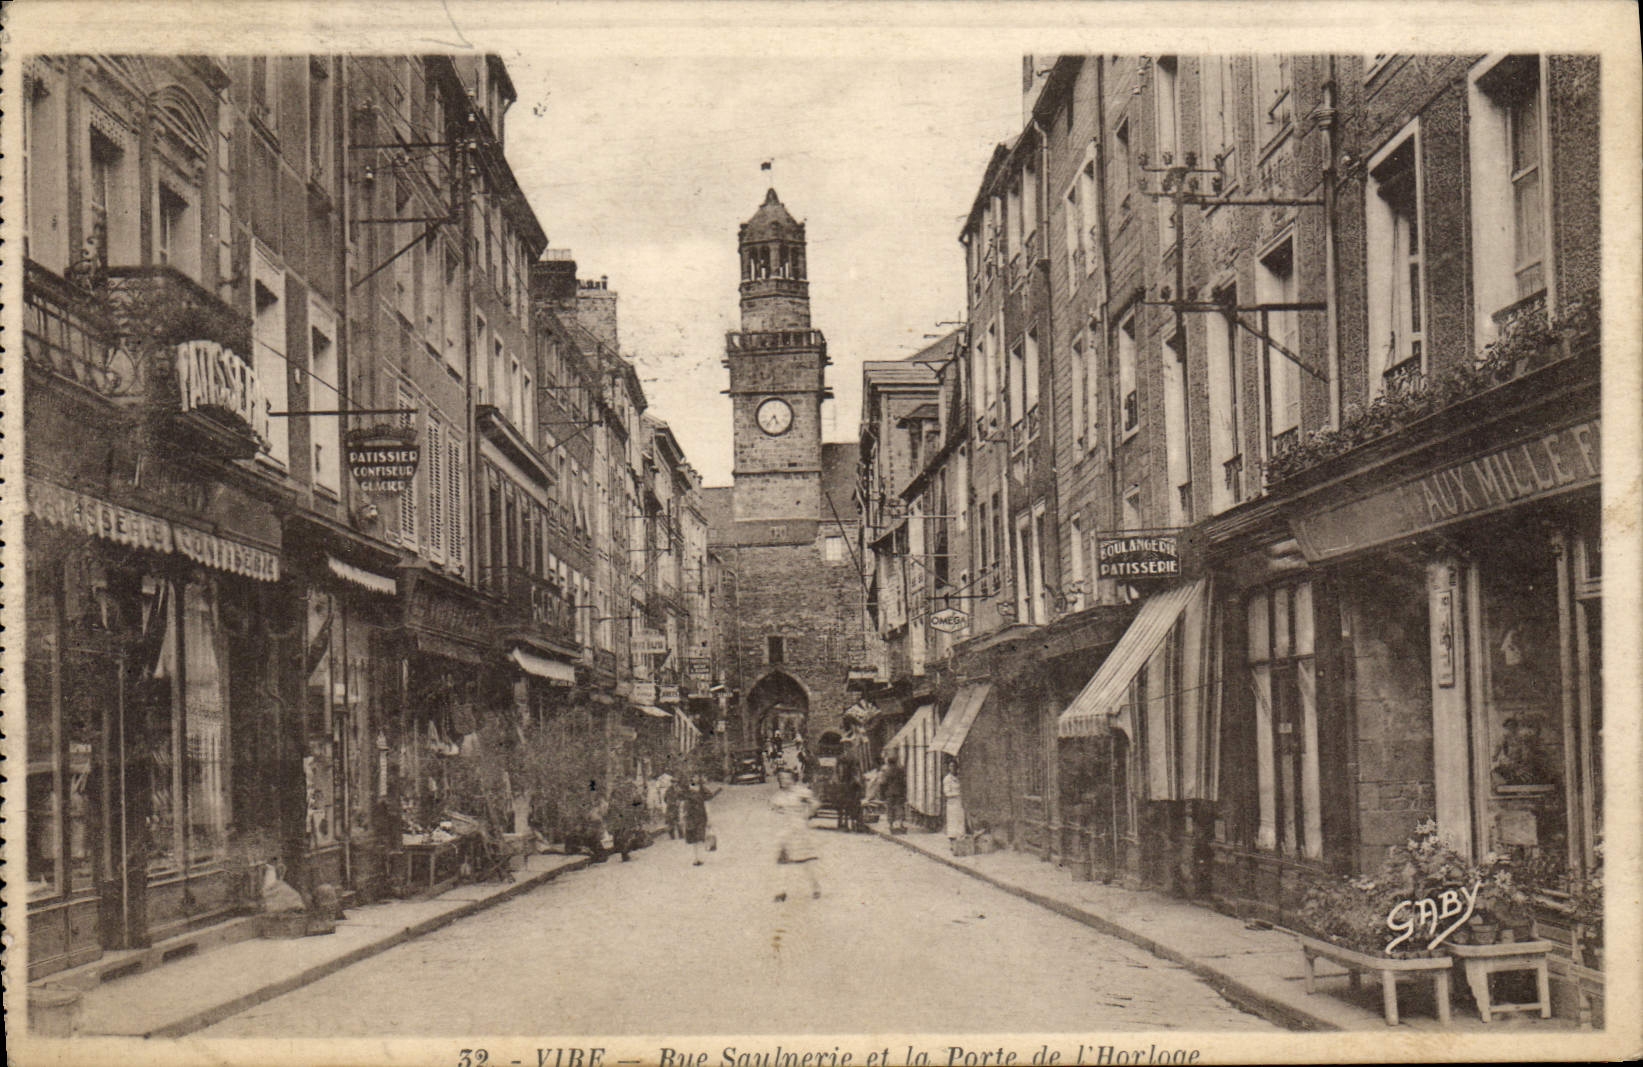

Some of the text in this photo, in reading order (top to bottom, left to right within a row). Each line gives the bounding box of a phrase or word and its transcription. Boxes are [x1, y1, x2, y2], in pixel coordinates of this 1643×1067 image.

[349, 450, 417, 463] PATISSIER
[353, 466, 413, 477] CONFISEUR
[1422, 419, 1600, 521] AUX MILLE F
[361, 481, 405, 492] GLACIER
[1101, 539, 1177, 560] BOULANGERIE
[1101, 561, 1177, 575] PATISSERIE
[931, 616, 966, 625] OMEGA
